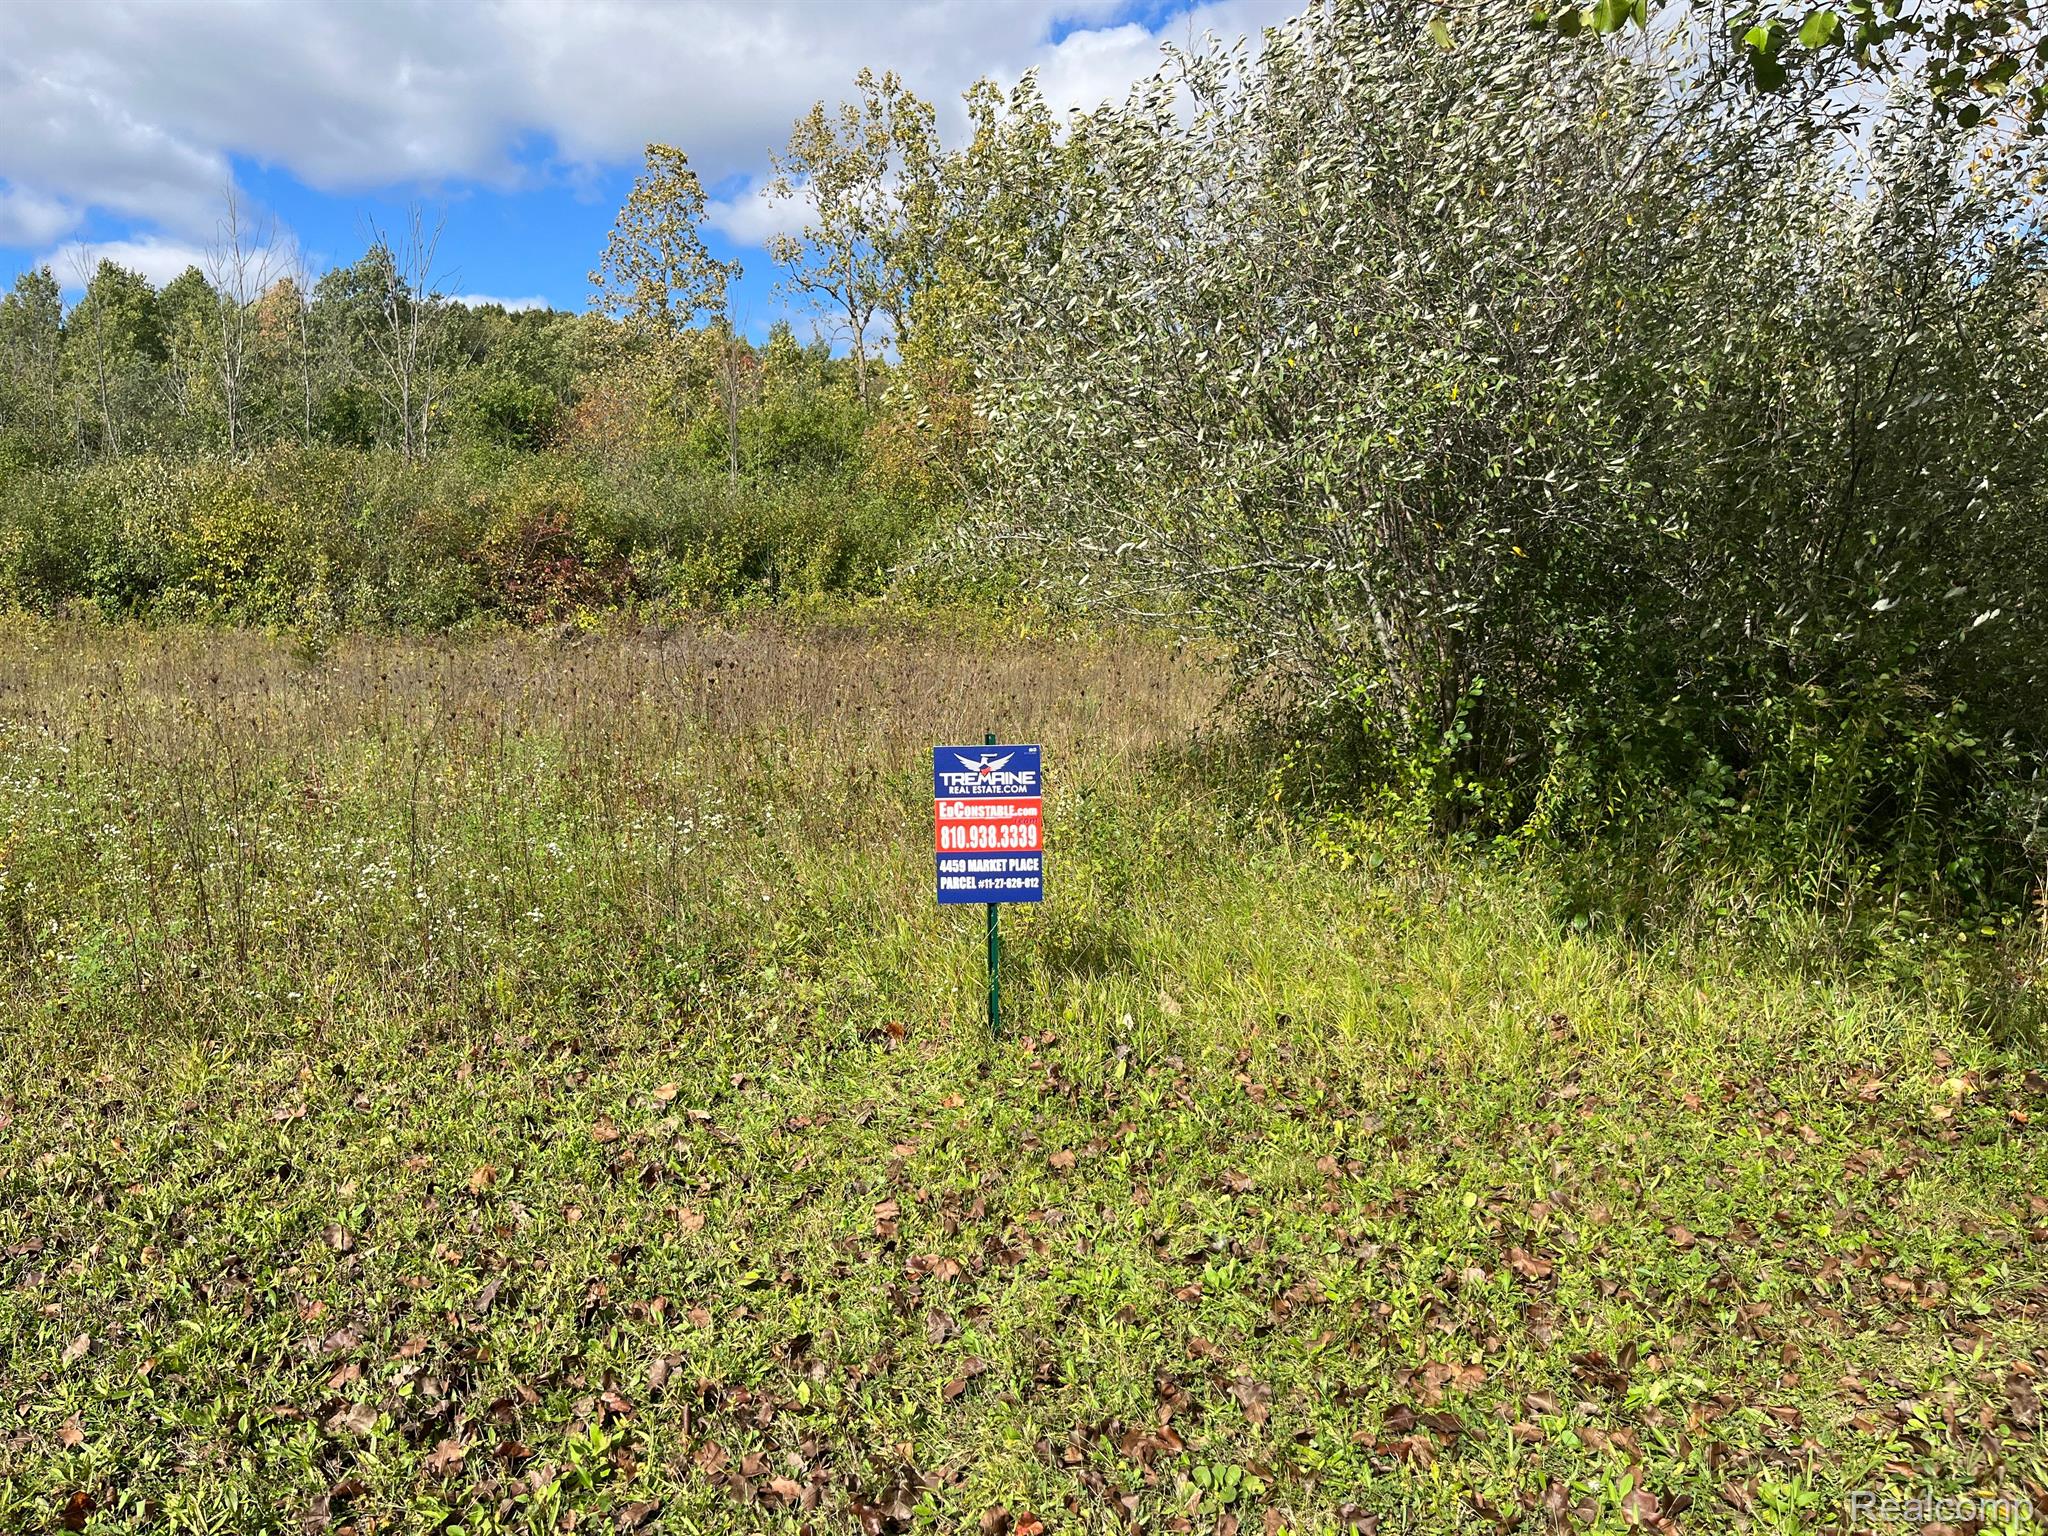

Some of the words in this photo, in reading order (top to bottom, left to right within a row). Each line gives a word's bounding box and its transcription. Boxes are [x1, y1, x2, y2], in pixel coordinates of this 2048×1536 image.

[939, 771, 1036, 786] TREMAINE
[948, 785, 970, 794] REAL
[972, 784, 1027, 794] ESTATE.COM
[941, 824, 1037, 849] 810.938.3339
[940, 859, 966, 872] 4459
[967, 858, 1007, 872] MARKET
[1009, 858, 1039, 871] PLACE
[940, 876, 976, 889] PARCEL
